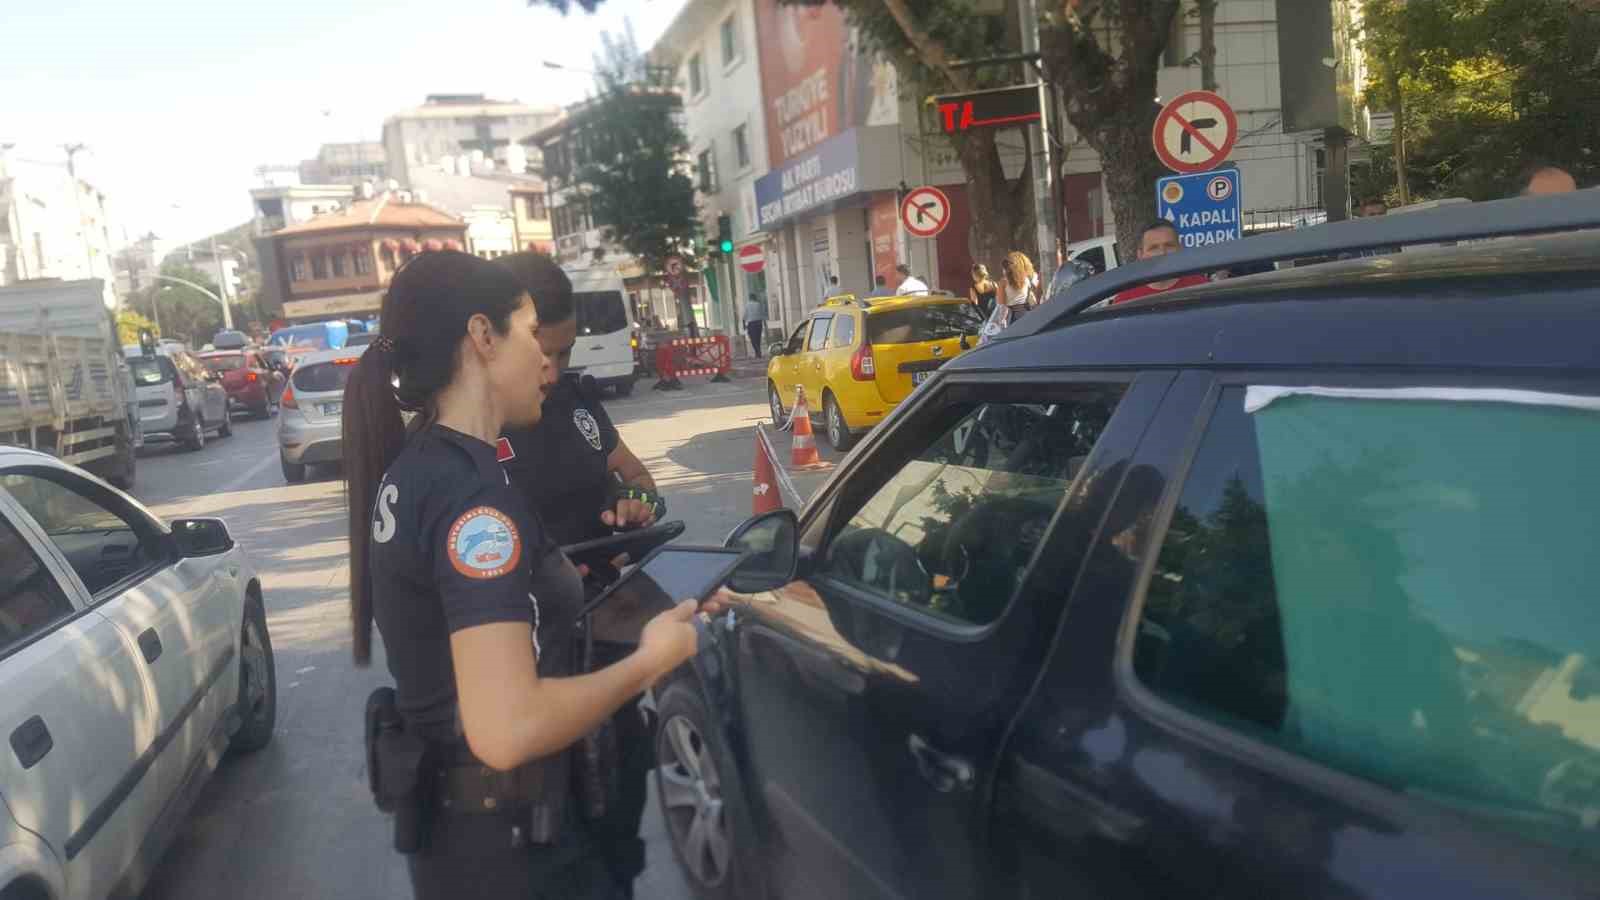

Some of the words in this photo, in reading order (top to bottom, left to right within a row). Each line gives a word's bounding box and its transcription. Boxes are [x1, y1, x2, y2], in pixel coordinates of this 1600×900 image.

[1179, 207, 1236, 228] KAPALI
[1178, 228, 1235, 248] TOPARK
[373, 484, 399, 544] S
